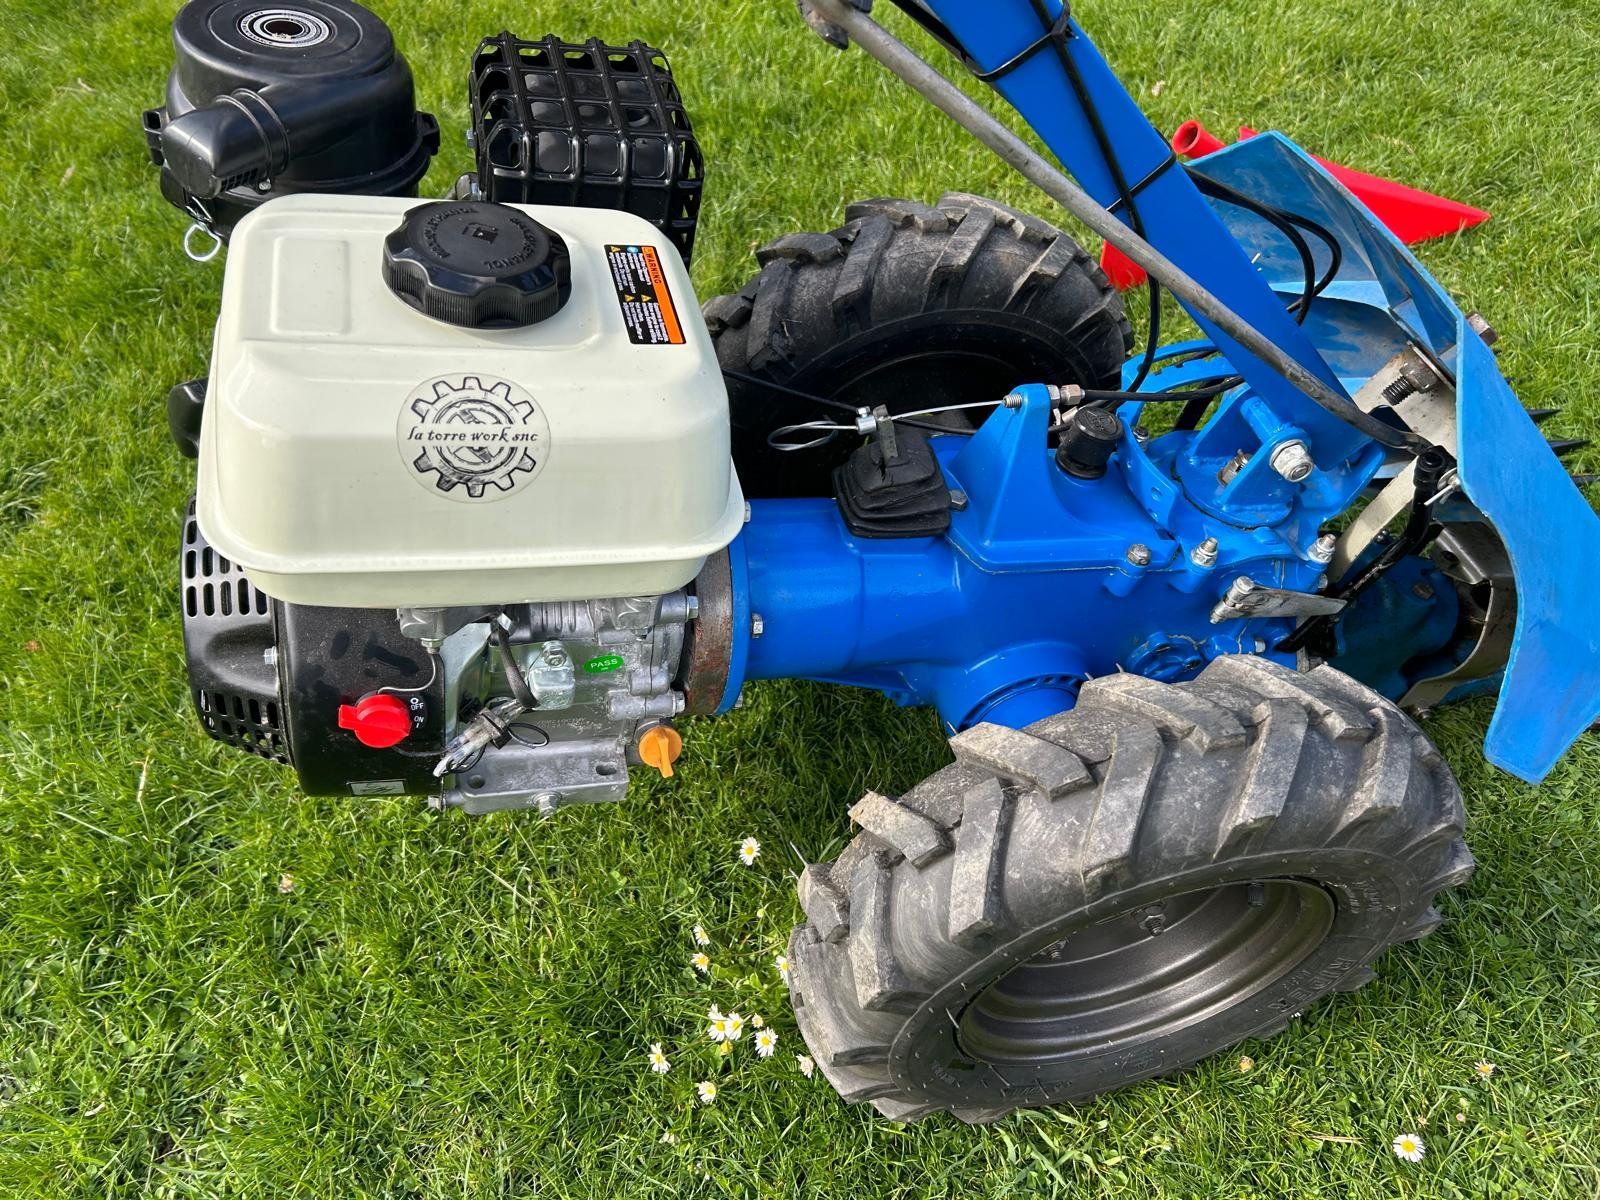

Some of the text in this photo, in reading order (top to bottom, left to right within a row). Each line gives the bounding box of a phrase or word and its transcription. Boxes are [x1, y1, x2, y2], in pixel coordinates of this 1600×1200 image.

[645, 253, 662, 284] WARNING
[427, 430, 467, 441] torre
[471, 426, 511, 442] work
[511, 432, 539, 442] snc
[590, 658, 618, 669] PASS
[410, 702, 424, 711] OFF
